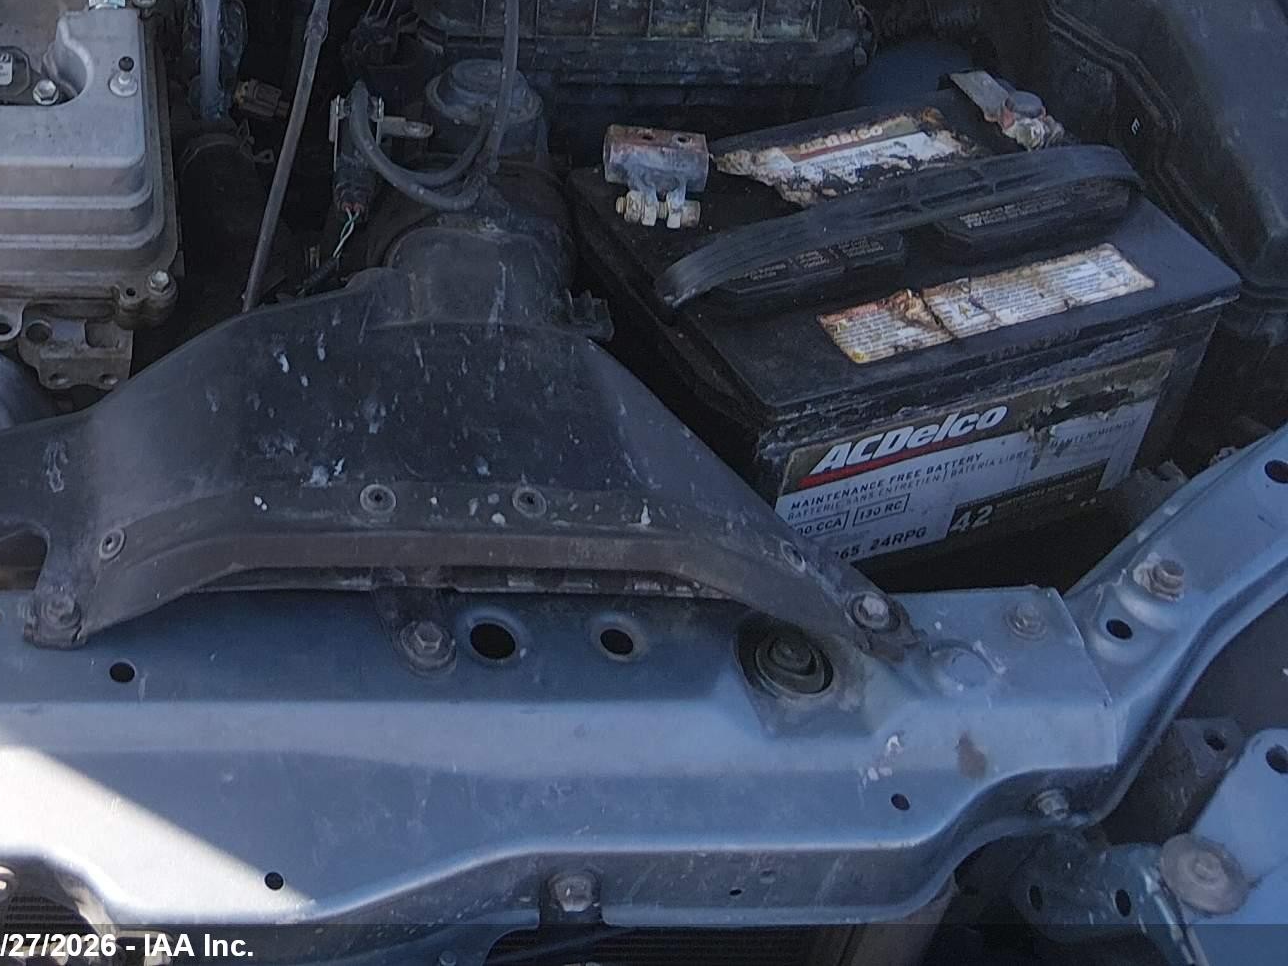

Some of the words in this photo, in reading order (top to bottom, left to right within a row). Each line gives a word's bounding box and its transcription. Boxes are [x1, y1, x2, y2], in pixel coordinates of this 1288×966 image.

[808, 405, 1008, 475] ACDelco
[790, 479, 884, 510] MAINTENANCE
[889, 468, 922, 485] FREE
[926, 452, 983, 475] BATTERY
[787, 501, 842, 521] BATTERIE
[877, 473, 941, 497] ENTRETIEN
[859, 507, 882, 521] 130
[884, 500, 904, 514] RC
[816, 516, 842, 532] CCA
[948, 504, 994, 533] 42
[869, 526, 928, 551] 24RPG
